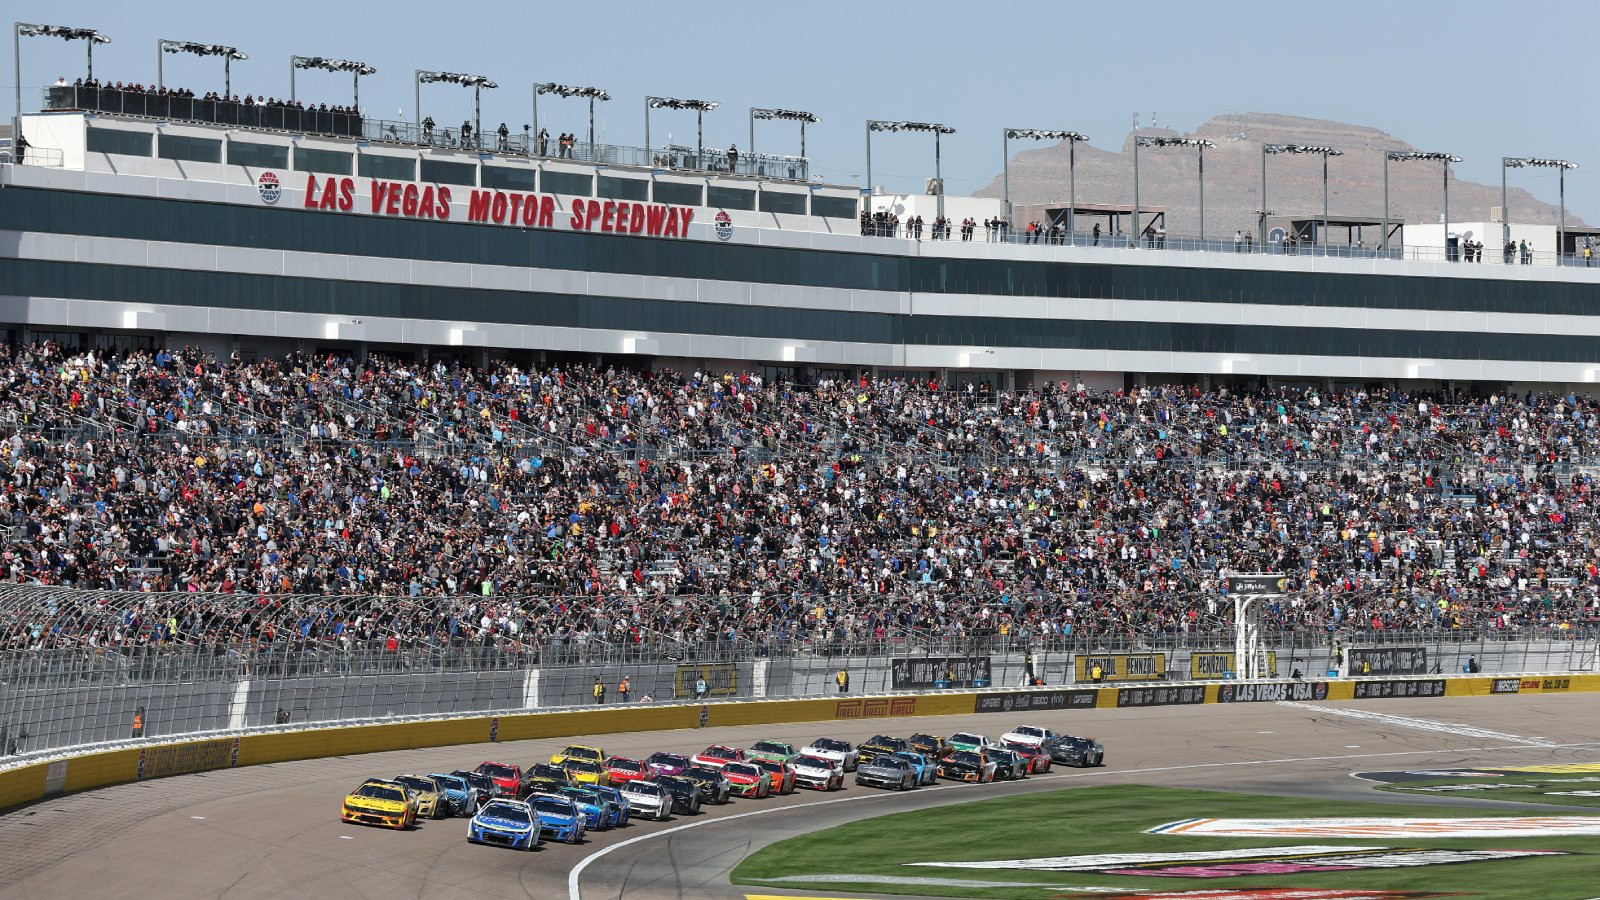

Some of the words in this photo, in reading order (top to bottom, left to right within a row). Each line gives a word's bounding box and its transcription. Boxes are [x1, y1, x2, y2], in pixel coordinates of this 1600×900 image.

[305, 175, 355, 211] LAS
[371, 180, 451, 219] VEGAS
[468, 190, 554, 227] MOTOR
[570, 198, 693, 237] SPEEDWAY
[1033, 696, 1048, 704] GEICO
[1235, 685, 1255, 701] LAS
[1256, 683, 1287, 700] VEGAS
[1293, 682, 1312, 700] USA
[836, 700, 862, 718] PIRELLI
[862, 698, 889, 717] PIRELLI
[890, 697, 917, 715] PIRELLI
